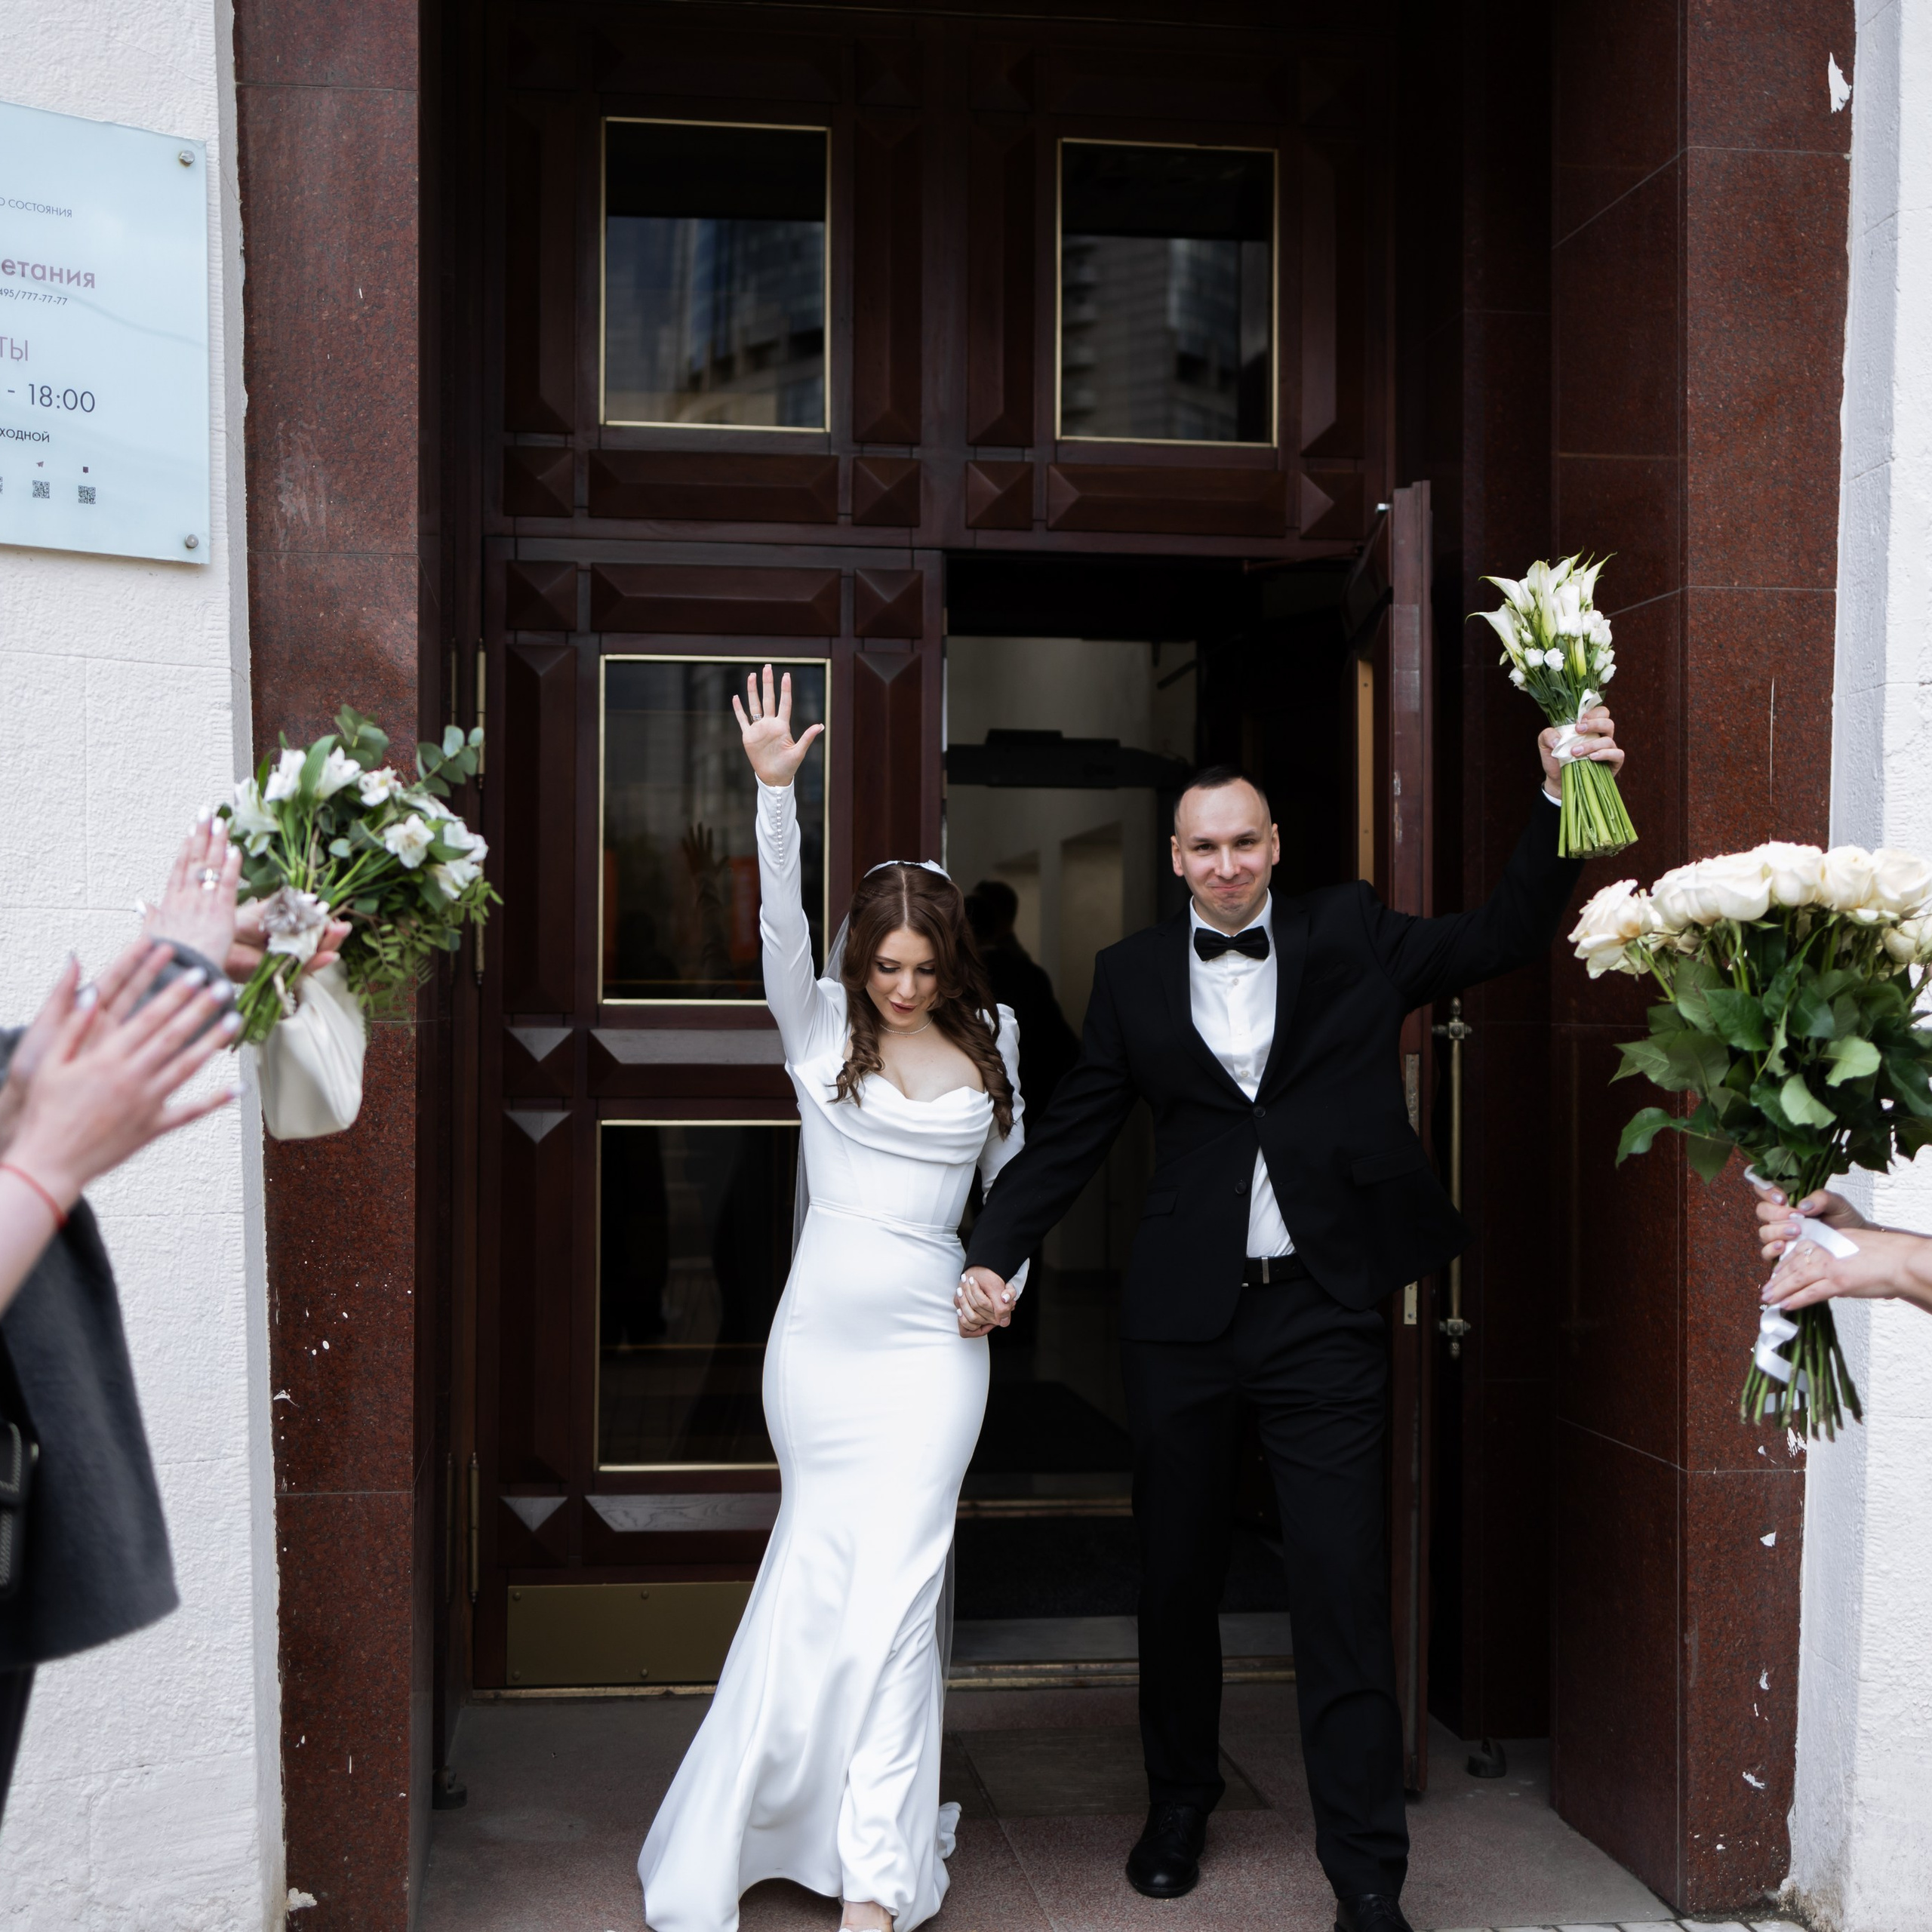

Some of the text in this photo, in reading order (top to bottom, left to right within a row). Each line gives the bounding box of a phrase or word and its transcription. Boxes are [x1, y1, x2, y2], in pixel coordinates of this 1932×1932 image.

[8, 199, 72, 218] СОСТОЯНИЯ
[1, 258, 96, 289] етания
[28, 383, 95, 413] 18:00
